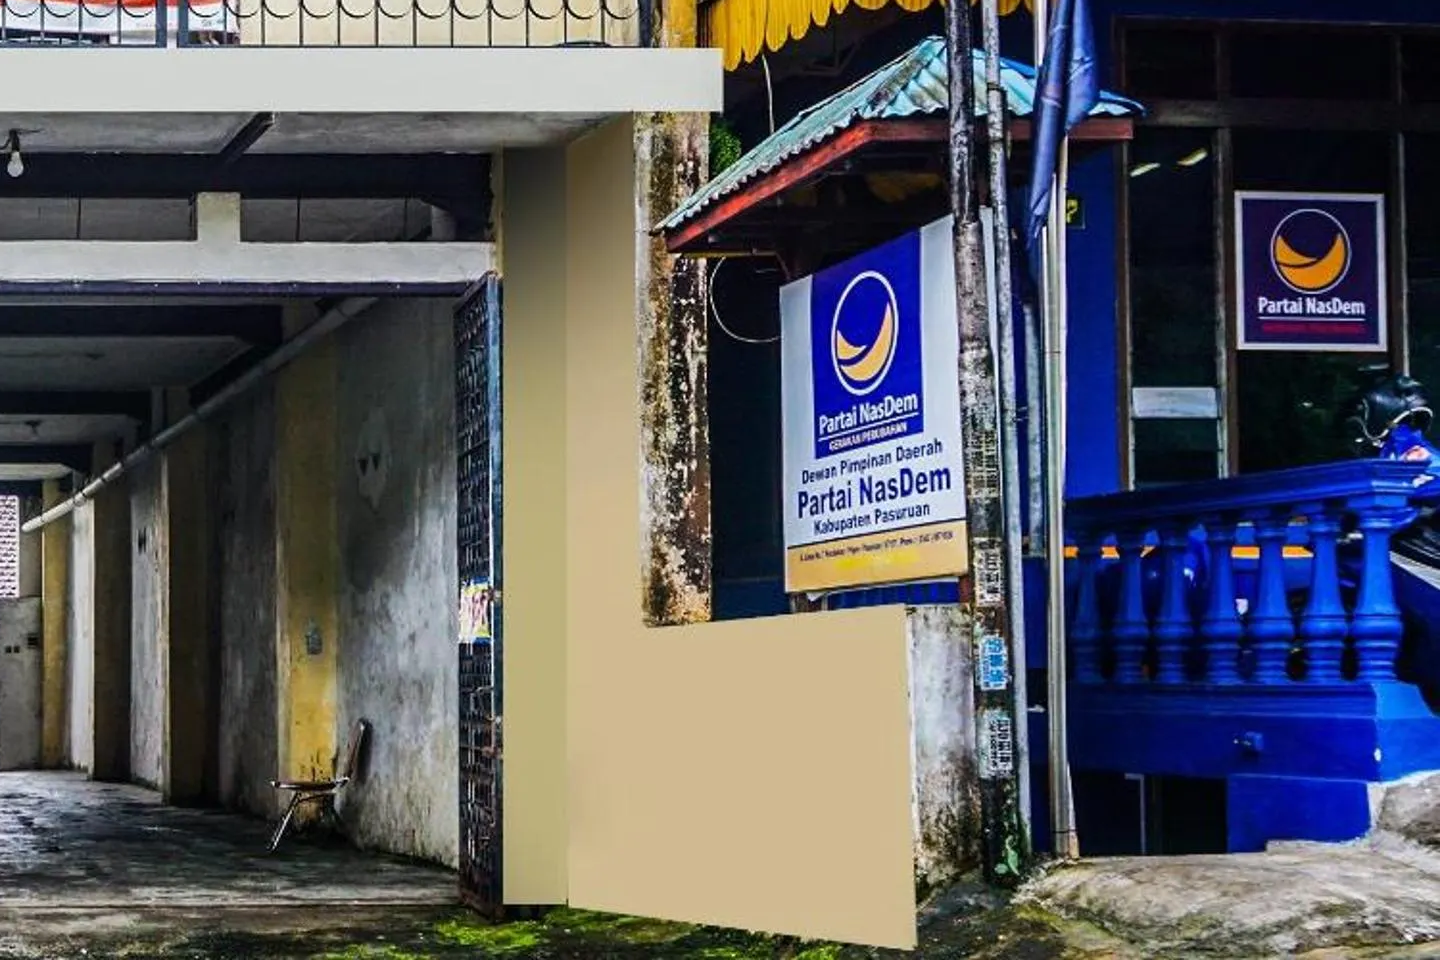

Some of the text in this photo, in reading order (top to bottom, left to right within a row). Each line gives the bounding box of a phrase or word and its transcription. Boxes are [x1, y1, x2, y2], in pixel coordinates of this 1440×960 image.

[1258, 297, 1365, 315] Partai NasDem
[819, 393, 918, 436] Partai NasDem
[802, 438, 943, 484] Dewan Pimpinan Daerah
[798, 467, 951, 518] Partai NasDem
[814, 504, 930, 534] Kabupaten Pasuruan
